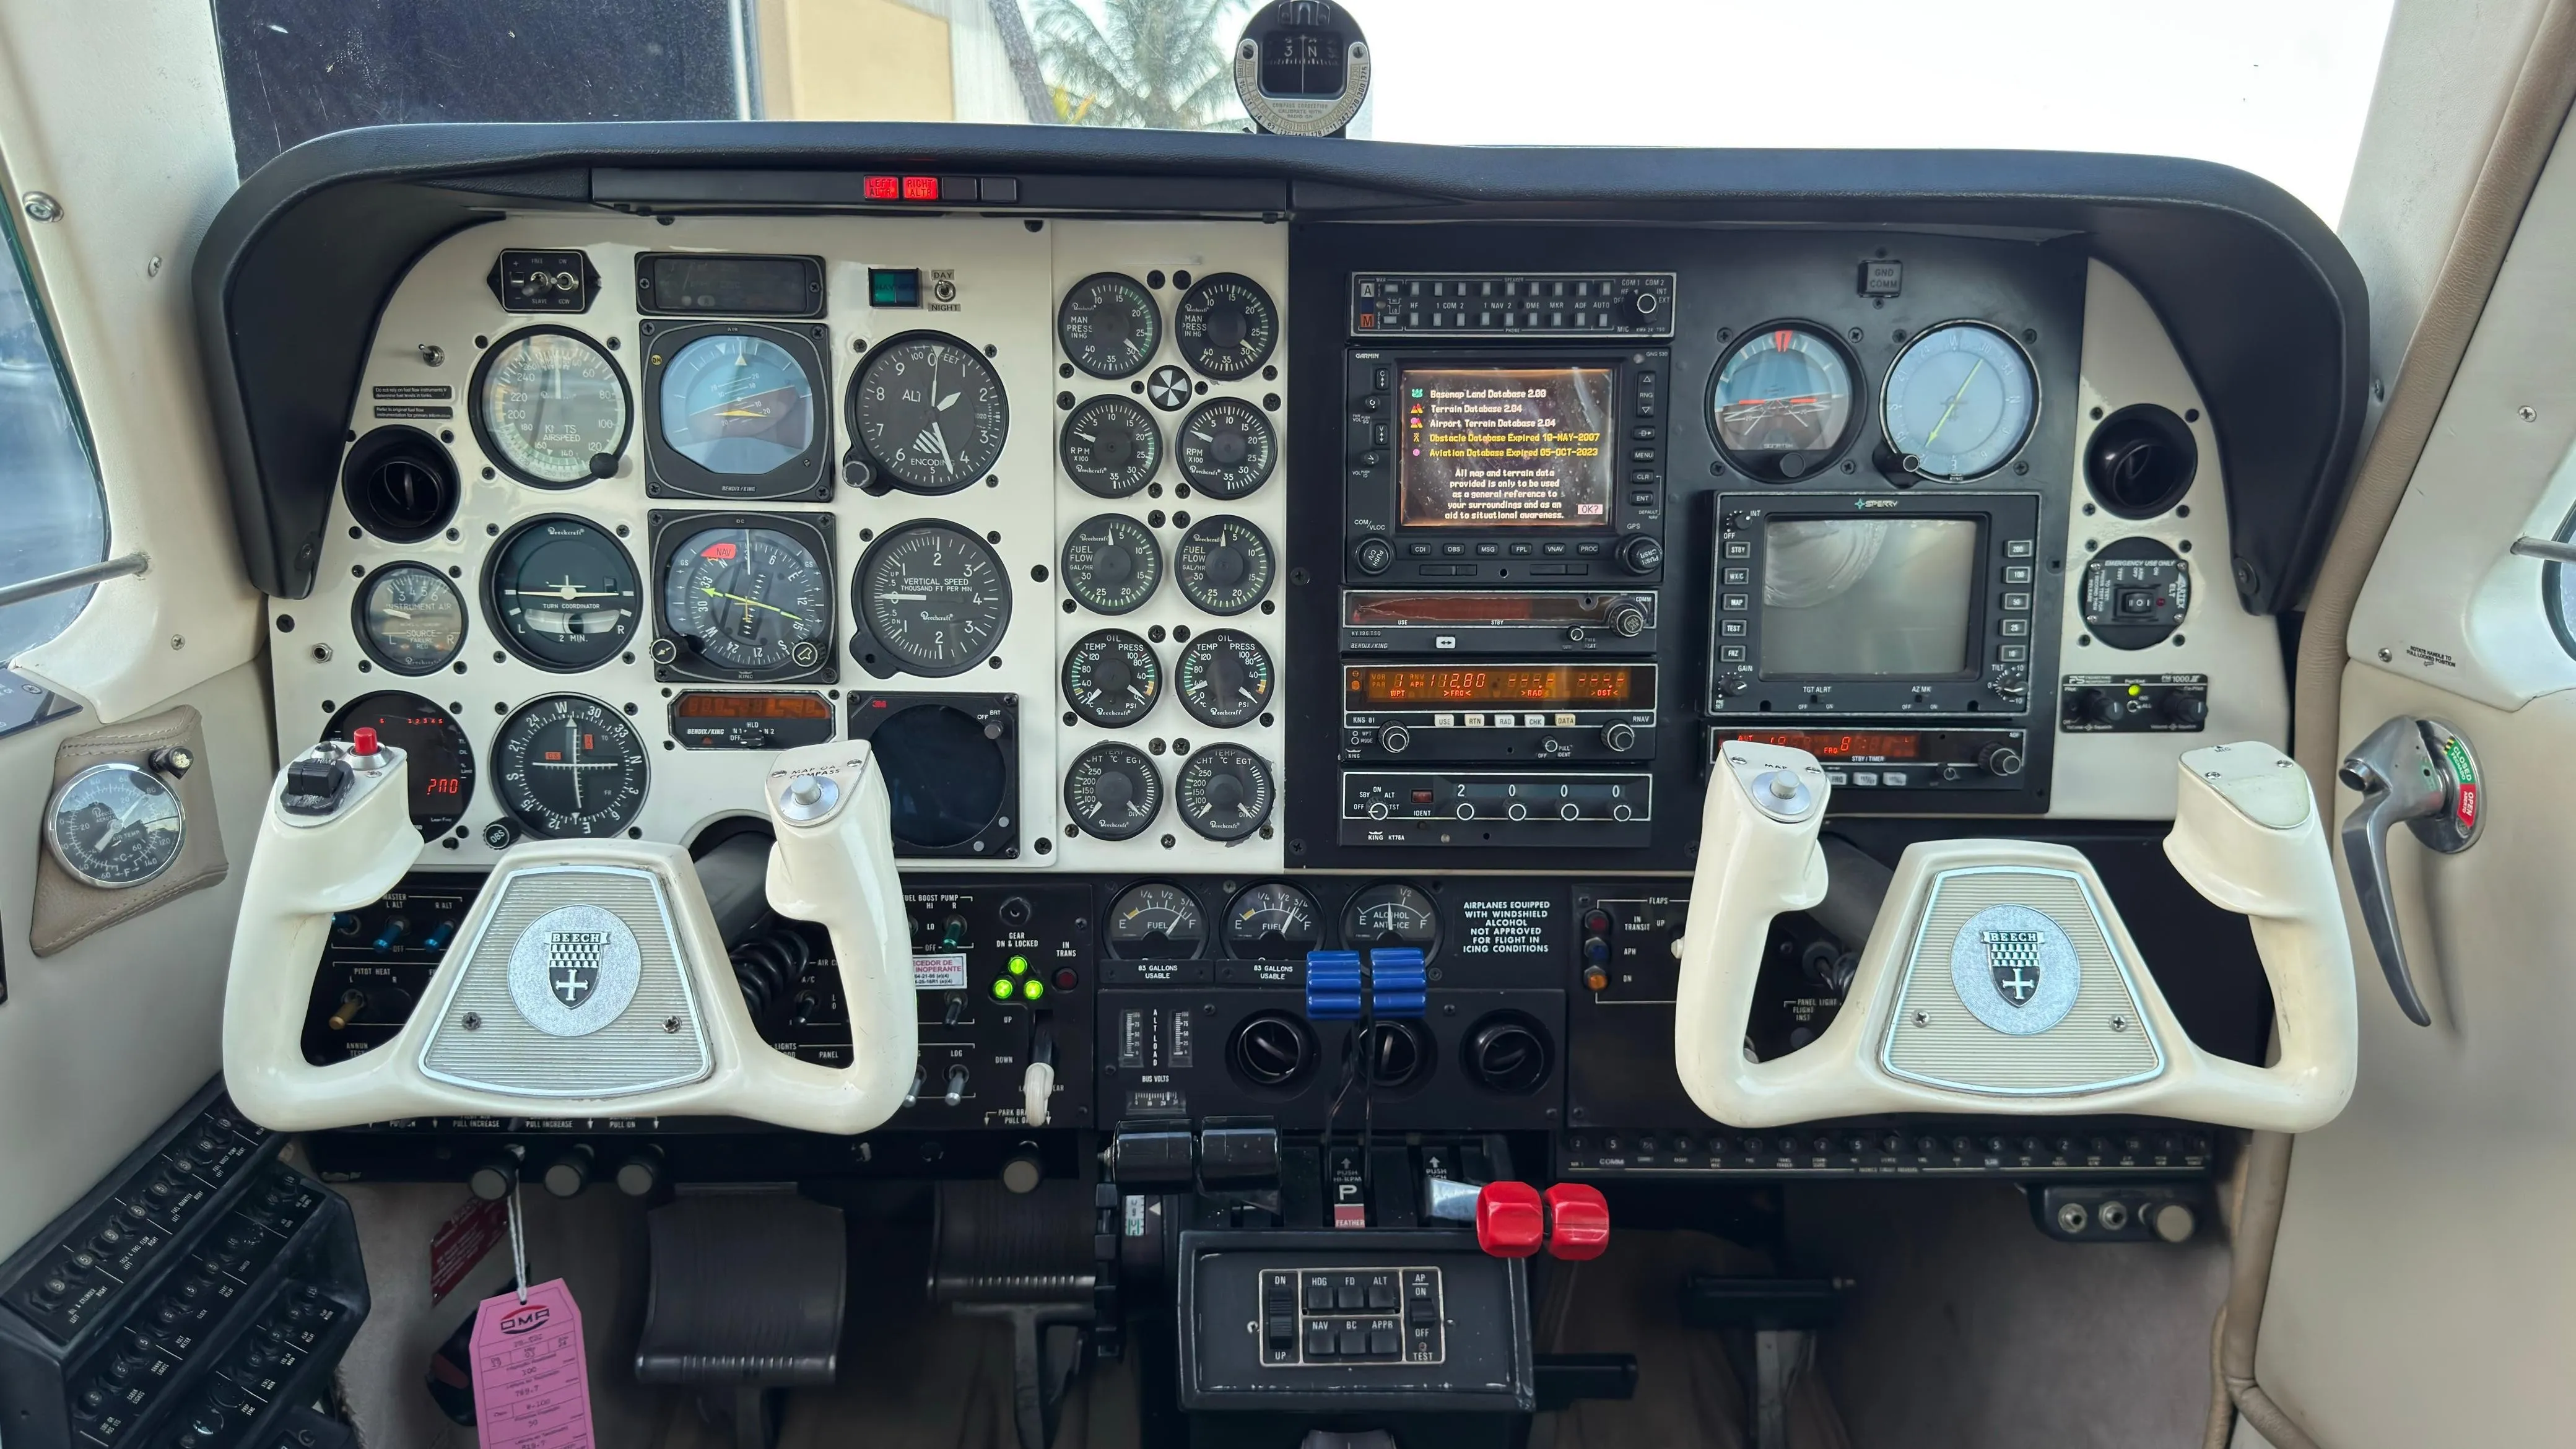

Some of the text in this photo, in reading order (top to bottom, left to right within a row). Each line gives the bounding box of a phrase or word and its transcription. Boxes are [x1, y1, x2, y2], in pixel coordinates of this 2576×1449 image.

[910, 188, 932, 197] ALTR
[933, 271, 952, 279] DAY
[1875, 269, 1894, 277] GND
[1870, 280, 1897, 288] COMM
[877, 388, 886, 400] 8
[980, 388, 987, 402] 2
[1430, 389, 1547, 399] Basemap Land Database 2.00
[1430, 404, 1522, 414] Terrain Database 2.04
[1429, 419, 1556, 429] Airport Terrain Database 2.04
[542, 433, 581, 442] AIRSPEED
[1429, 433, 1466, 442] Obstacle
[1468, 433, 1506, 442] Database
[1507, 432, 1539, 442] Expired
[1429, 447, 1598, 457] Aviation Database Expired 05-OCT-2023
[1455, 469, 1468, 477] All
[1469, 470, 1485, 478] map
[1502, 469, 1534, 477] terrain
[1450, 479, 1560, 488] provided only used
[1471, 489, 1546, 499] general reference
[1468, 500, 1522, 509] surroundings
[1523, 500, 1538, 508] and
[1471, 510, 1518, 519] situational
[716, 547, 731, 557] NAV
[1070, 554, 1094, 562] FLOW
[904, 578, 941, 586] VERTICAL
[406, 629, 437, 638] SOURCE
[1196, 643, 1219, 651] TEMP
[2453, 747, 2472, 781] CLOSED
[2466, 791, 2474, 816] OPEN
[490, 830, 505, 843] OBS
[552, 934, 601, 942] BEECH
[1990, 933, 2037, 942] BEECH
[1339, 1185, 1357, 1200] P
[1312, 1277, 1328, 1286] HDG
[1373, 1276, 1387, 1286] ALT
[1312, 1320, 1329, 1330] NAV
[1372, 1320, 1393, 1329] APPR
[1416, 1329, 1429, 1338] OFF
[1274, 1351, 1286, 1360] UP
[1413, 1352, 1433, 1361] TEST
